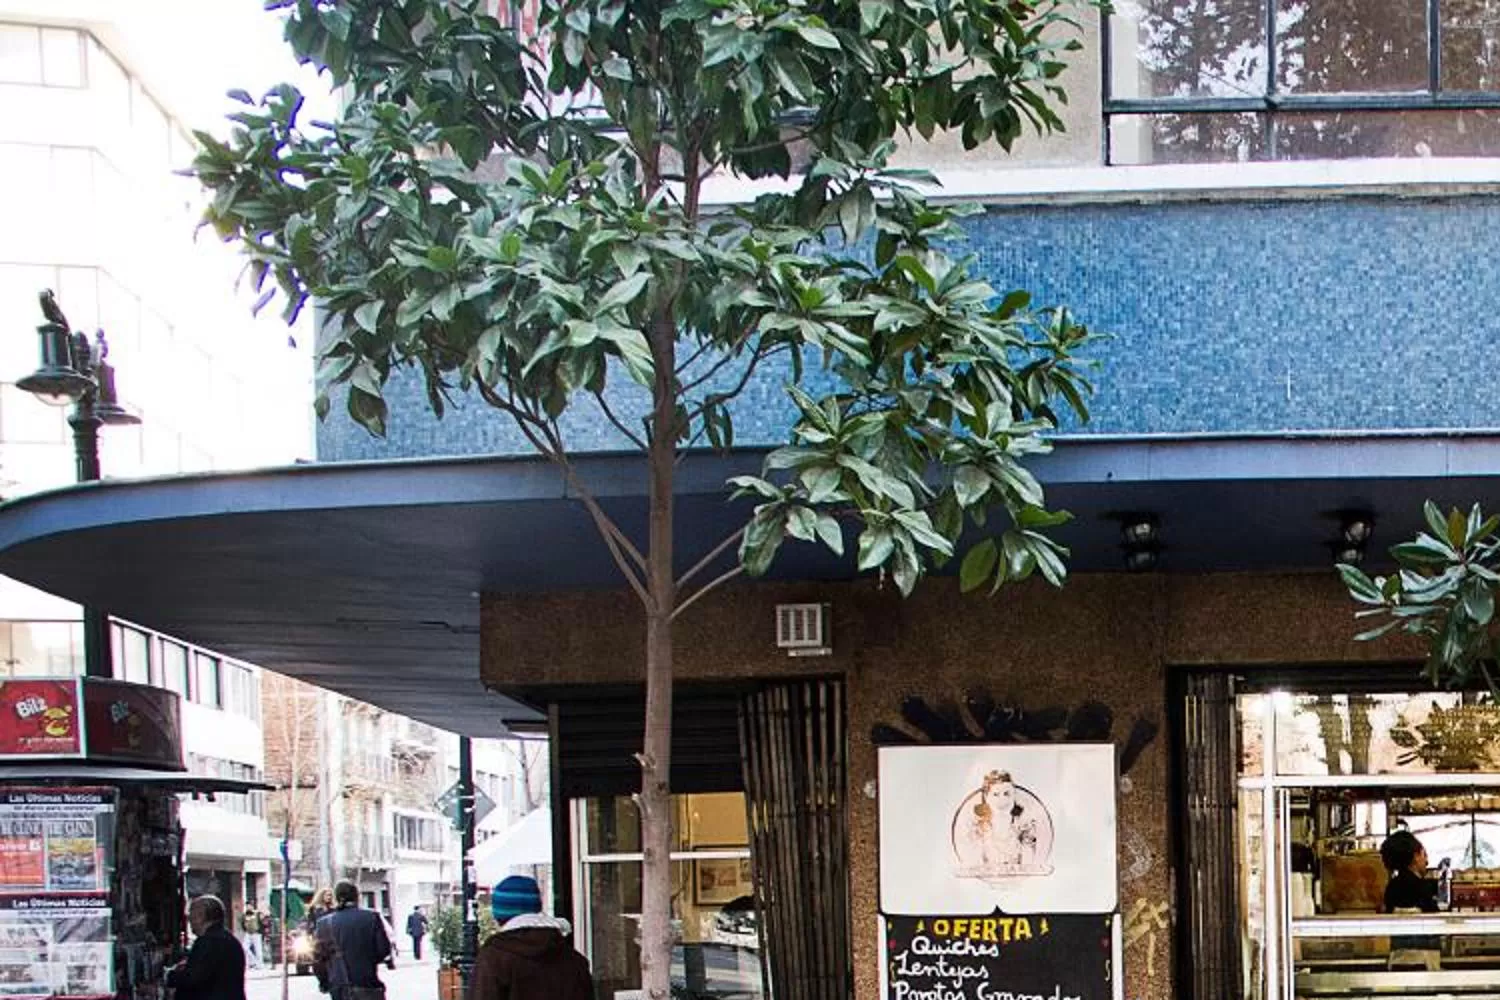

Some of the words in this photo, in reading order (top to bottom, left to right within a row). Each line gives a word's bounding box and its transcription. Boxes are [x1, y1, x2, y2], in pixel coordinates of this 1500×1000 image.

[933, 917, 1032, 942] OFERTA
[911, 935, 999, 957] Quiches
[894, 950, 989, 988] Lentejas
